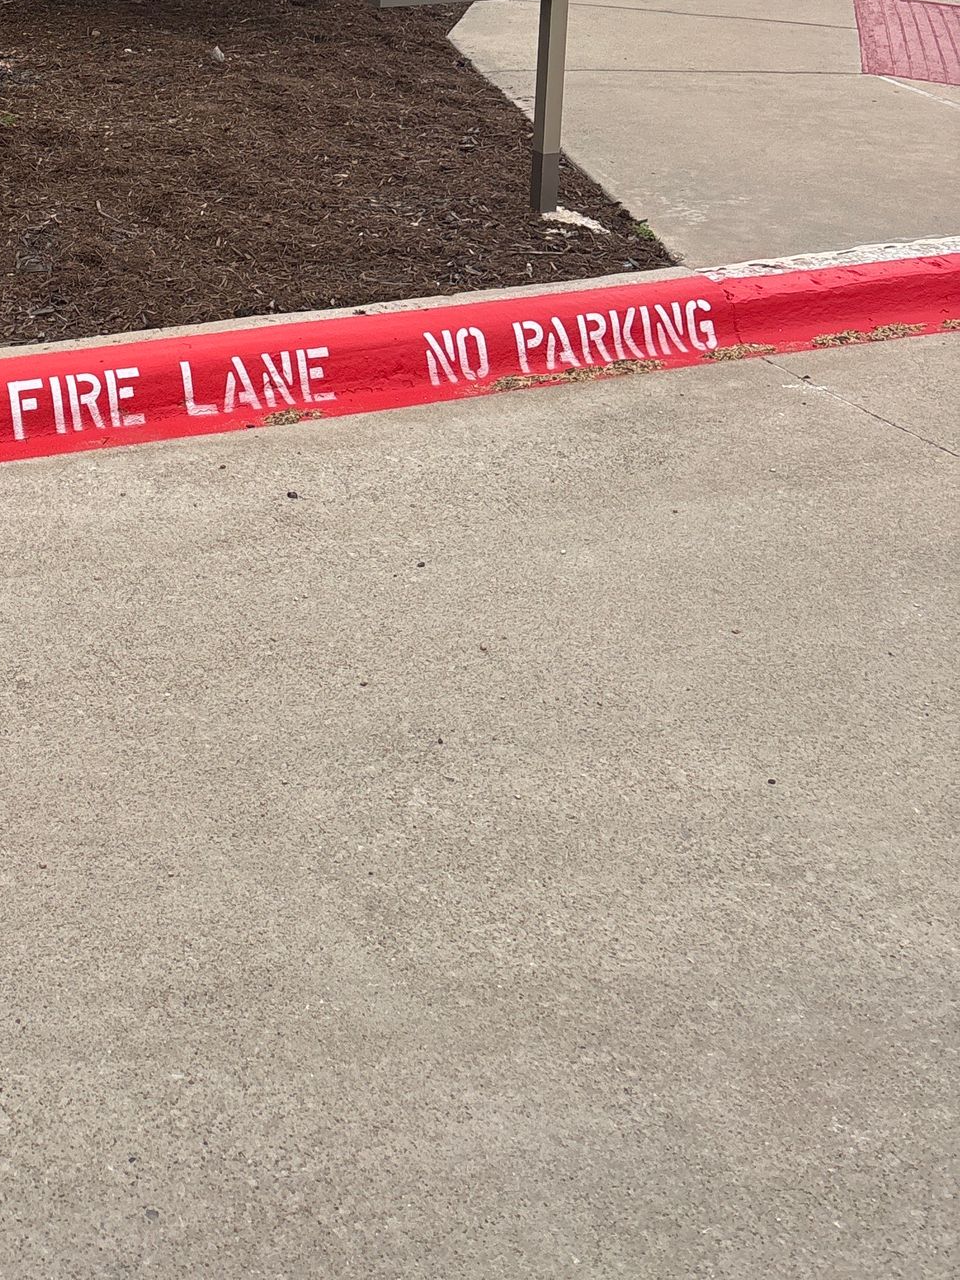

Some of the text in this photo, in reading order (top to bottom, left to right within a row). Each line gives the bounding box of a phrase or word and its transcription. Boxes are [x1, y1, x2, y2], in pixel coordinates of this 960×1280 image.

[6, 298, 719, 440] FIRE LANE NO PARKING
